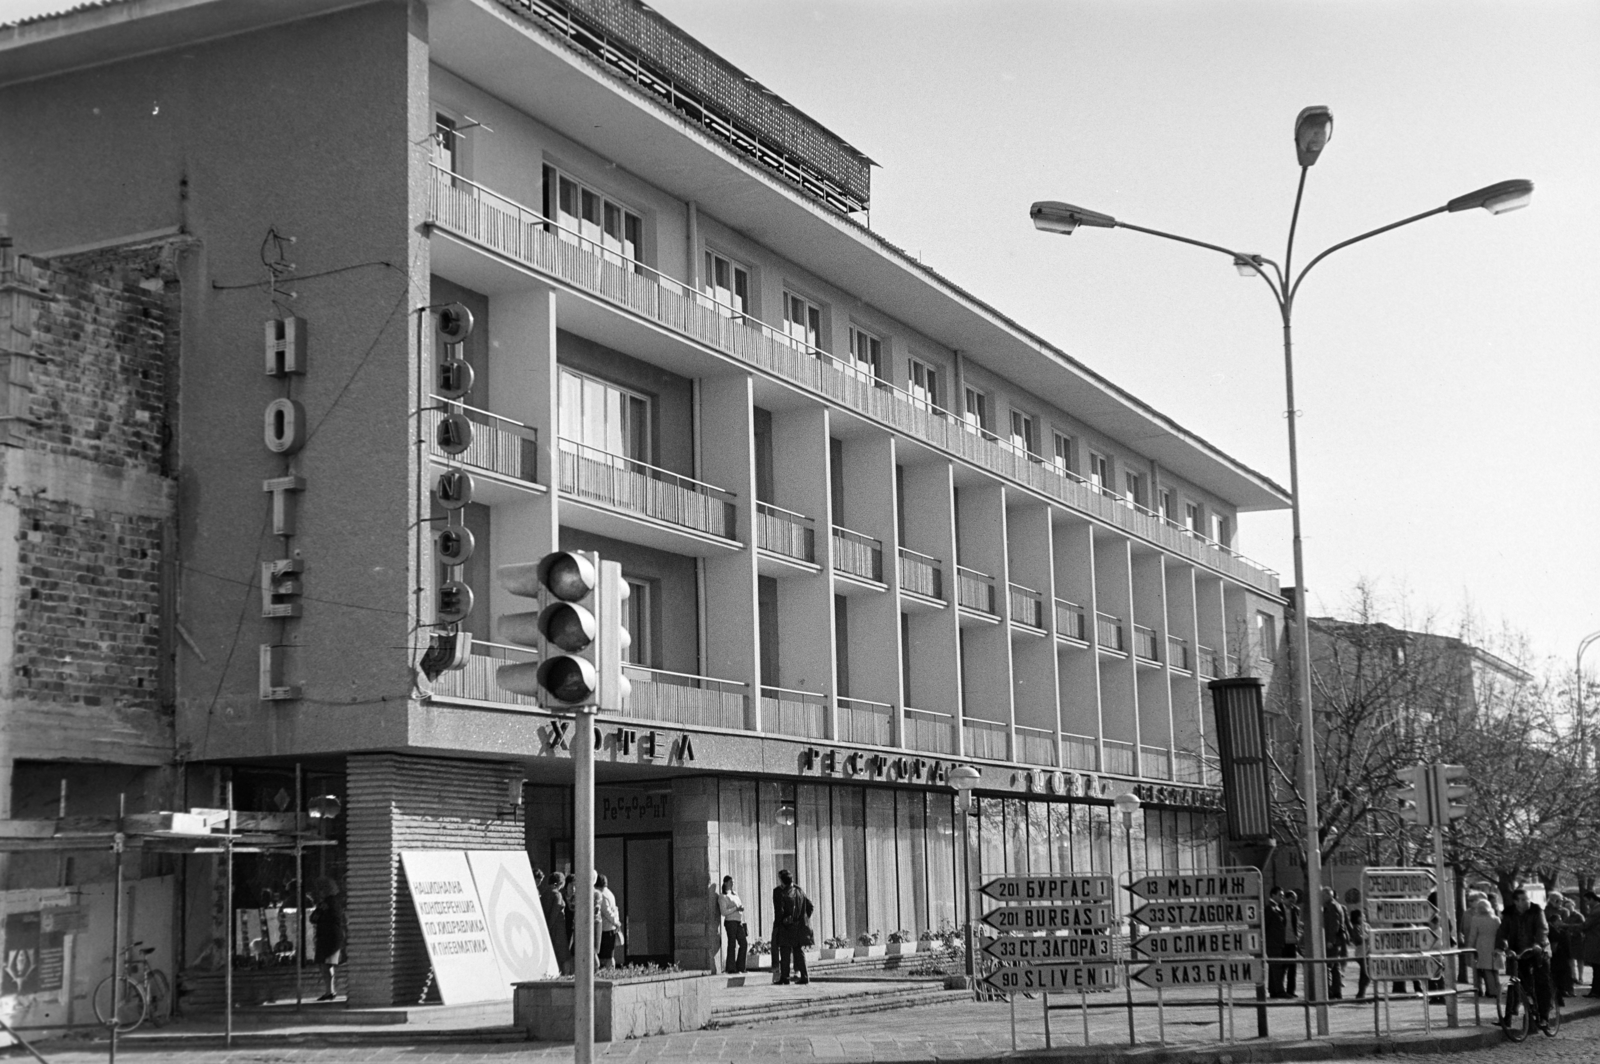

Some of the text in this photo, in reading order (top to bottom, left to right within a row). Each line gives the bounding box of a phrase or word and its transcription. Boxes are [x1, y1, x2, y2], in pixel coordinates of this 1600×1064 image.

[437, 305, 466, 617] CHANGE
[259, 316, 307, 701] HOTEL
[806, 747, 982, 784] РЕСТОРА
[412, 880, 464, 895] НАЦИОНАЛНА
[999, 882, 1019, 897] 201
[1026, 879, 1090, 898] БУРГАС
[1147, 877, 1245, 897] 13 МЪГЛИЖ
[418, 900, 476, 915] КОНФЕРЕНЦИЯ
[1149, 904, 1255, 923] 33 ST.ZAGORA 3
[1377, 902, 1422, 920] МОРОЗОВО
[999, 911, 1019, 926] 201
[1025, 908, 1093, 927] BURGAS
[424, 919, 486, 936] ПО ХИДРАВЛИКА
[430, 939, 488, 956] И ПНЕВМАТИКА
[1000, 938, 1108, 958] 33 СТ.ЗАГОРА 3
[1151, 938, 1167, 952] 90
[1173, 933, 1243, 953] СЛИВЕН
[1374, 932, 1420, 950] БУЗОВГРАД
[1155, 963, 1252, 984] 5 КАЗ.БАНИ
[1391, 959, 1428, 976] КАЗАНЛЪК
[1002, 972, 1018, 987] 90
[1025, 968, 1096, 988] SLIVEN
